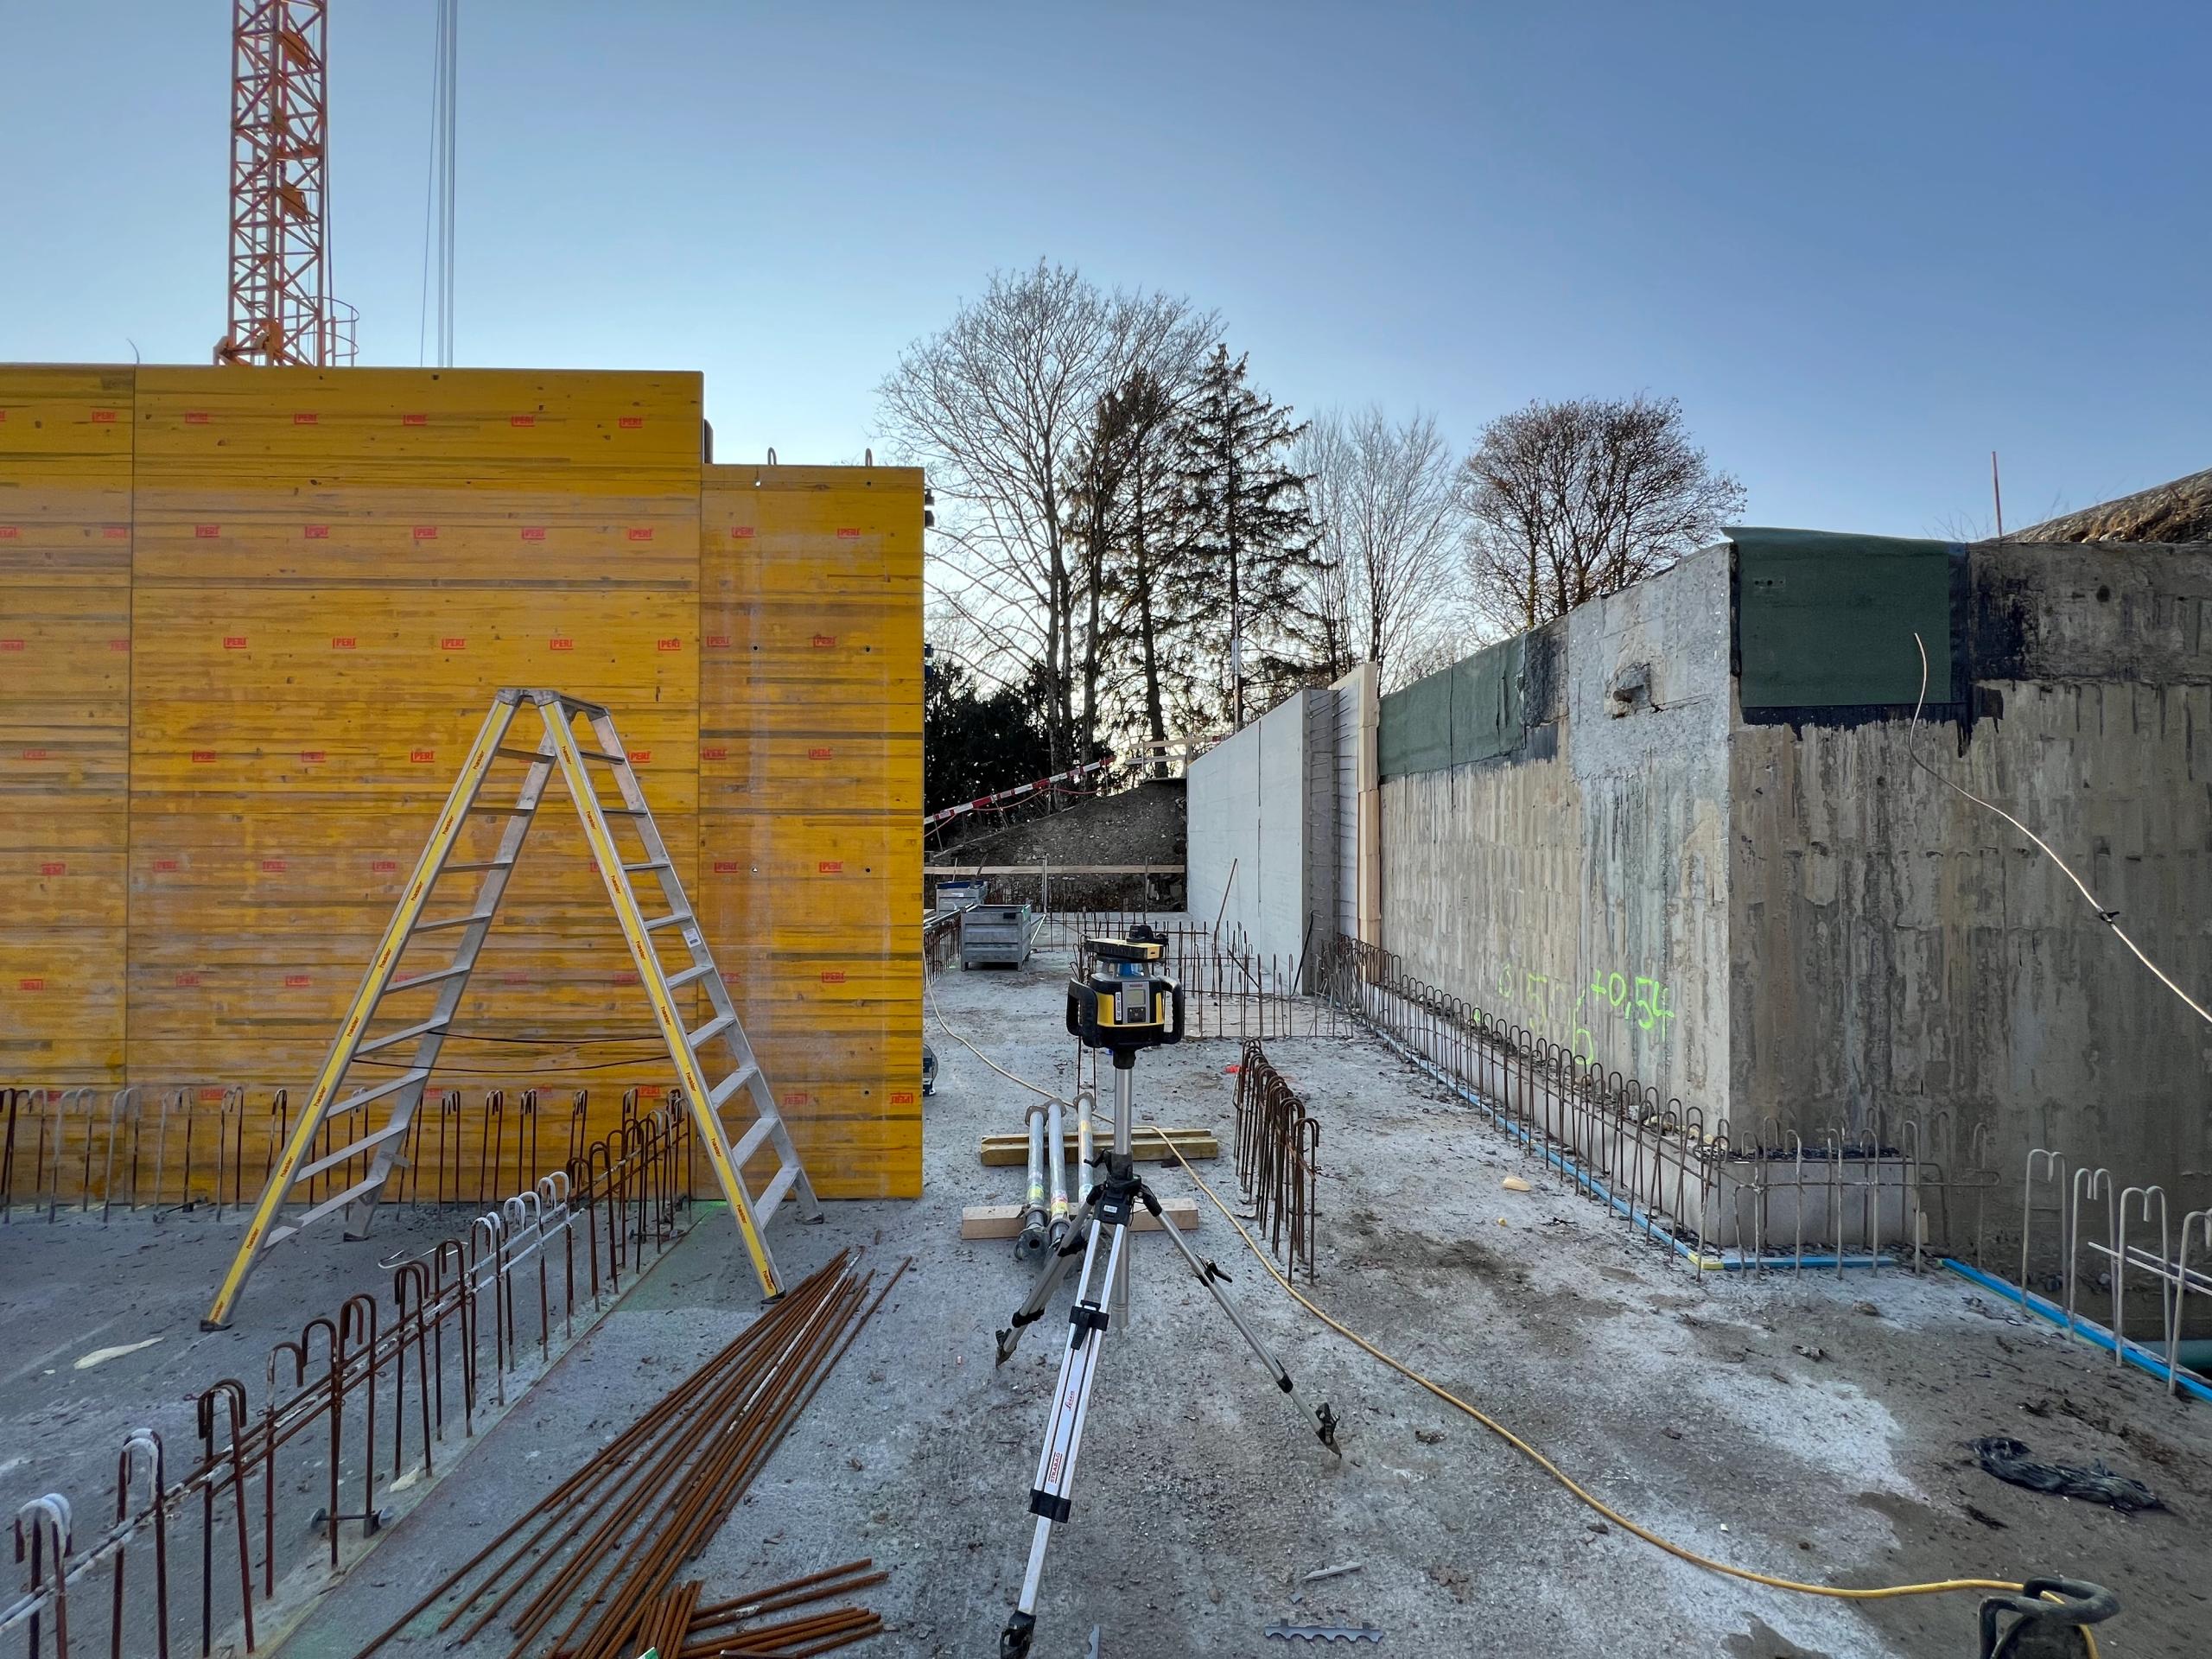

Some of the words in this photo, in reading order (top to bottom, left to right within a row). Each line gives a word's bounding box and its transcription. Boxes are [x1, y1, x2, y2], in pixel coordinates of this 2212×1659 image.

[621, 416, 642, 426] PERI
[631, 528, 652, 537] PERI
[839, 527, 860, 537] PERI
[226, 637, 246, 646] PERI
[336, 637, 355, 646] PERI
[444, 638, 464, 647] PERI
[552, 638, 573, 649] PERI
[660, 639, 679, 649] PERI
[414, 751, 433, 760] PERI
[704, 748, 725, 757] PERI
[812, 748, 830, 757] PERI
[822, 861, 842, 871] PERI
[1065, 1390, 1075, 1411] Leica
[1050, 1452, 1061, 1483] STRABAG
